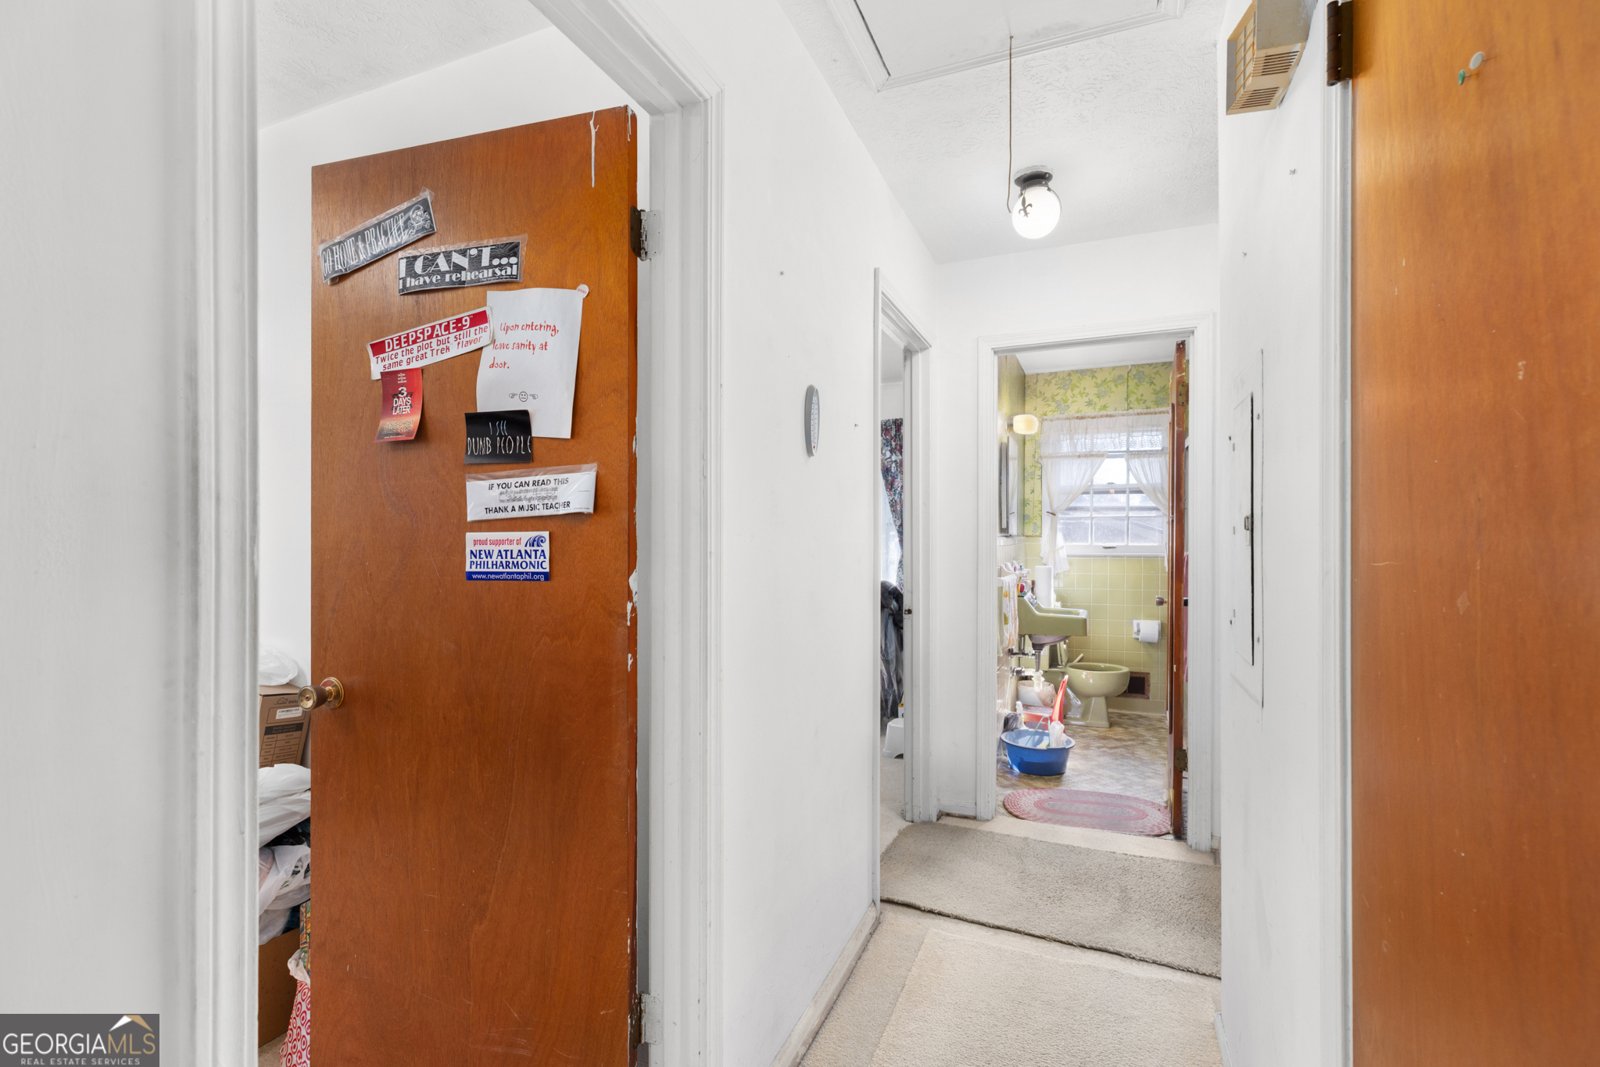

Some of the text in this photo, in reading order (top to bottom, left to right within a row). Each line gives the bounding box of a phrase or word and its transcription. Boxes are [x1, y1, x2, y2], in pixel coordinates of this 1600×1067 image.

[333, 238, 357, 272] HOME
[365, 213, 409, 256] PRACTICE
[399, 246, 518, 278] I CAN'T...
[406, 274, 441, 288] have
[445, 264, 518, 282] rehearsal
[384, 316, 471, 352] DEEPSPACE-9
[500, 320, 559, 337] Upon entering,
[375, 325, 489, 364] Twice the plot but still the
[511, 339, 536, 355] sanity
[539, 341, 548, 351] at
[382, 359, 404, 371] same
[406, 352, 428, 366] great
[457, 336, 483, 350] flavor
[489, 356, 510, 369] door.
[398, 386, 407, 397] 3
[393, 396, 411, 407] DAYS
[392, 405, 411, 415] LATER
[488, 420, 508, 436] I SEE
[467, 436, 532, 456] DUMB PEOPLE
[496, 482, 512, 490] YOU
[514, 480, 530, 489] CAN
[532, 478, 551, 487] READ
[554, 477, 569, 485] THIS
[485, 505, 508, 514] THANK
[511, 504, 516, 512] A
[473, 537, 522, 547] proud supporter of
[470, 549, 547, 560] NEW ATLANTA
[469, 560, 547, 570] PHILHARMONIC
[472, 572, 545, 581] www.newatlantaphil.org
